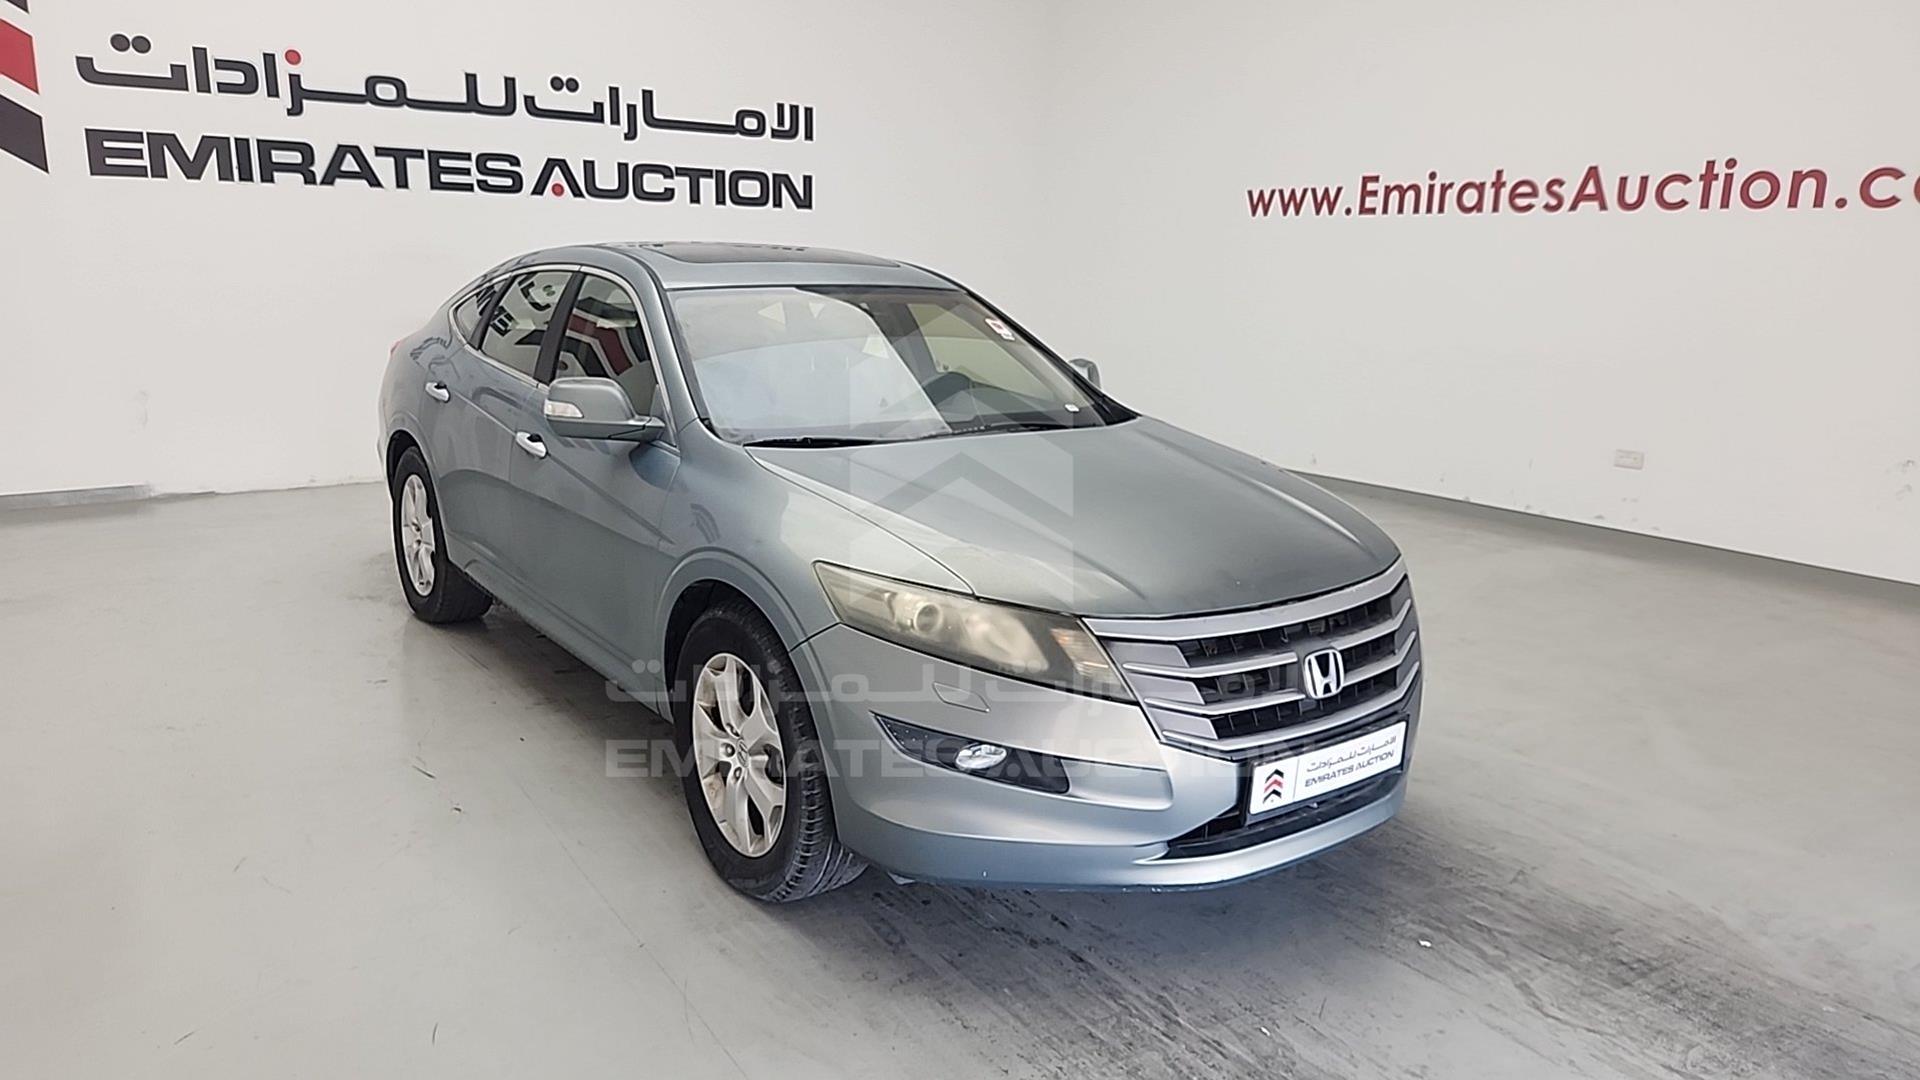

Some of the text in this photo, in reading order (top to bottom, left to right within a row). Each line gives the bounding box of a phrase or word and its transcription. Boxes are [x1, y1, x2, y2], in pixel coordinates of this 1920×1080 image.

[85, 128, 813, 210] EMIRATES AUCTION
[1246, 158, 1920, 217] www.EmiratesAuction.c
[1305, 749, 1395, 787] EMIRATES AUCTION
